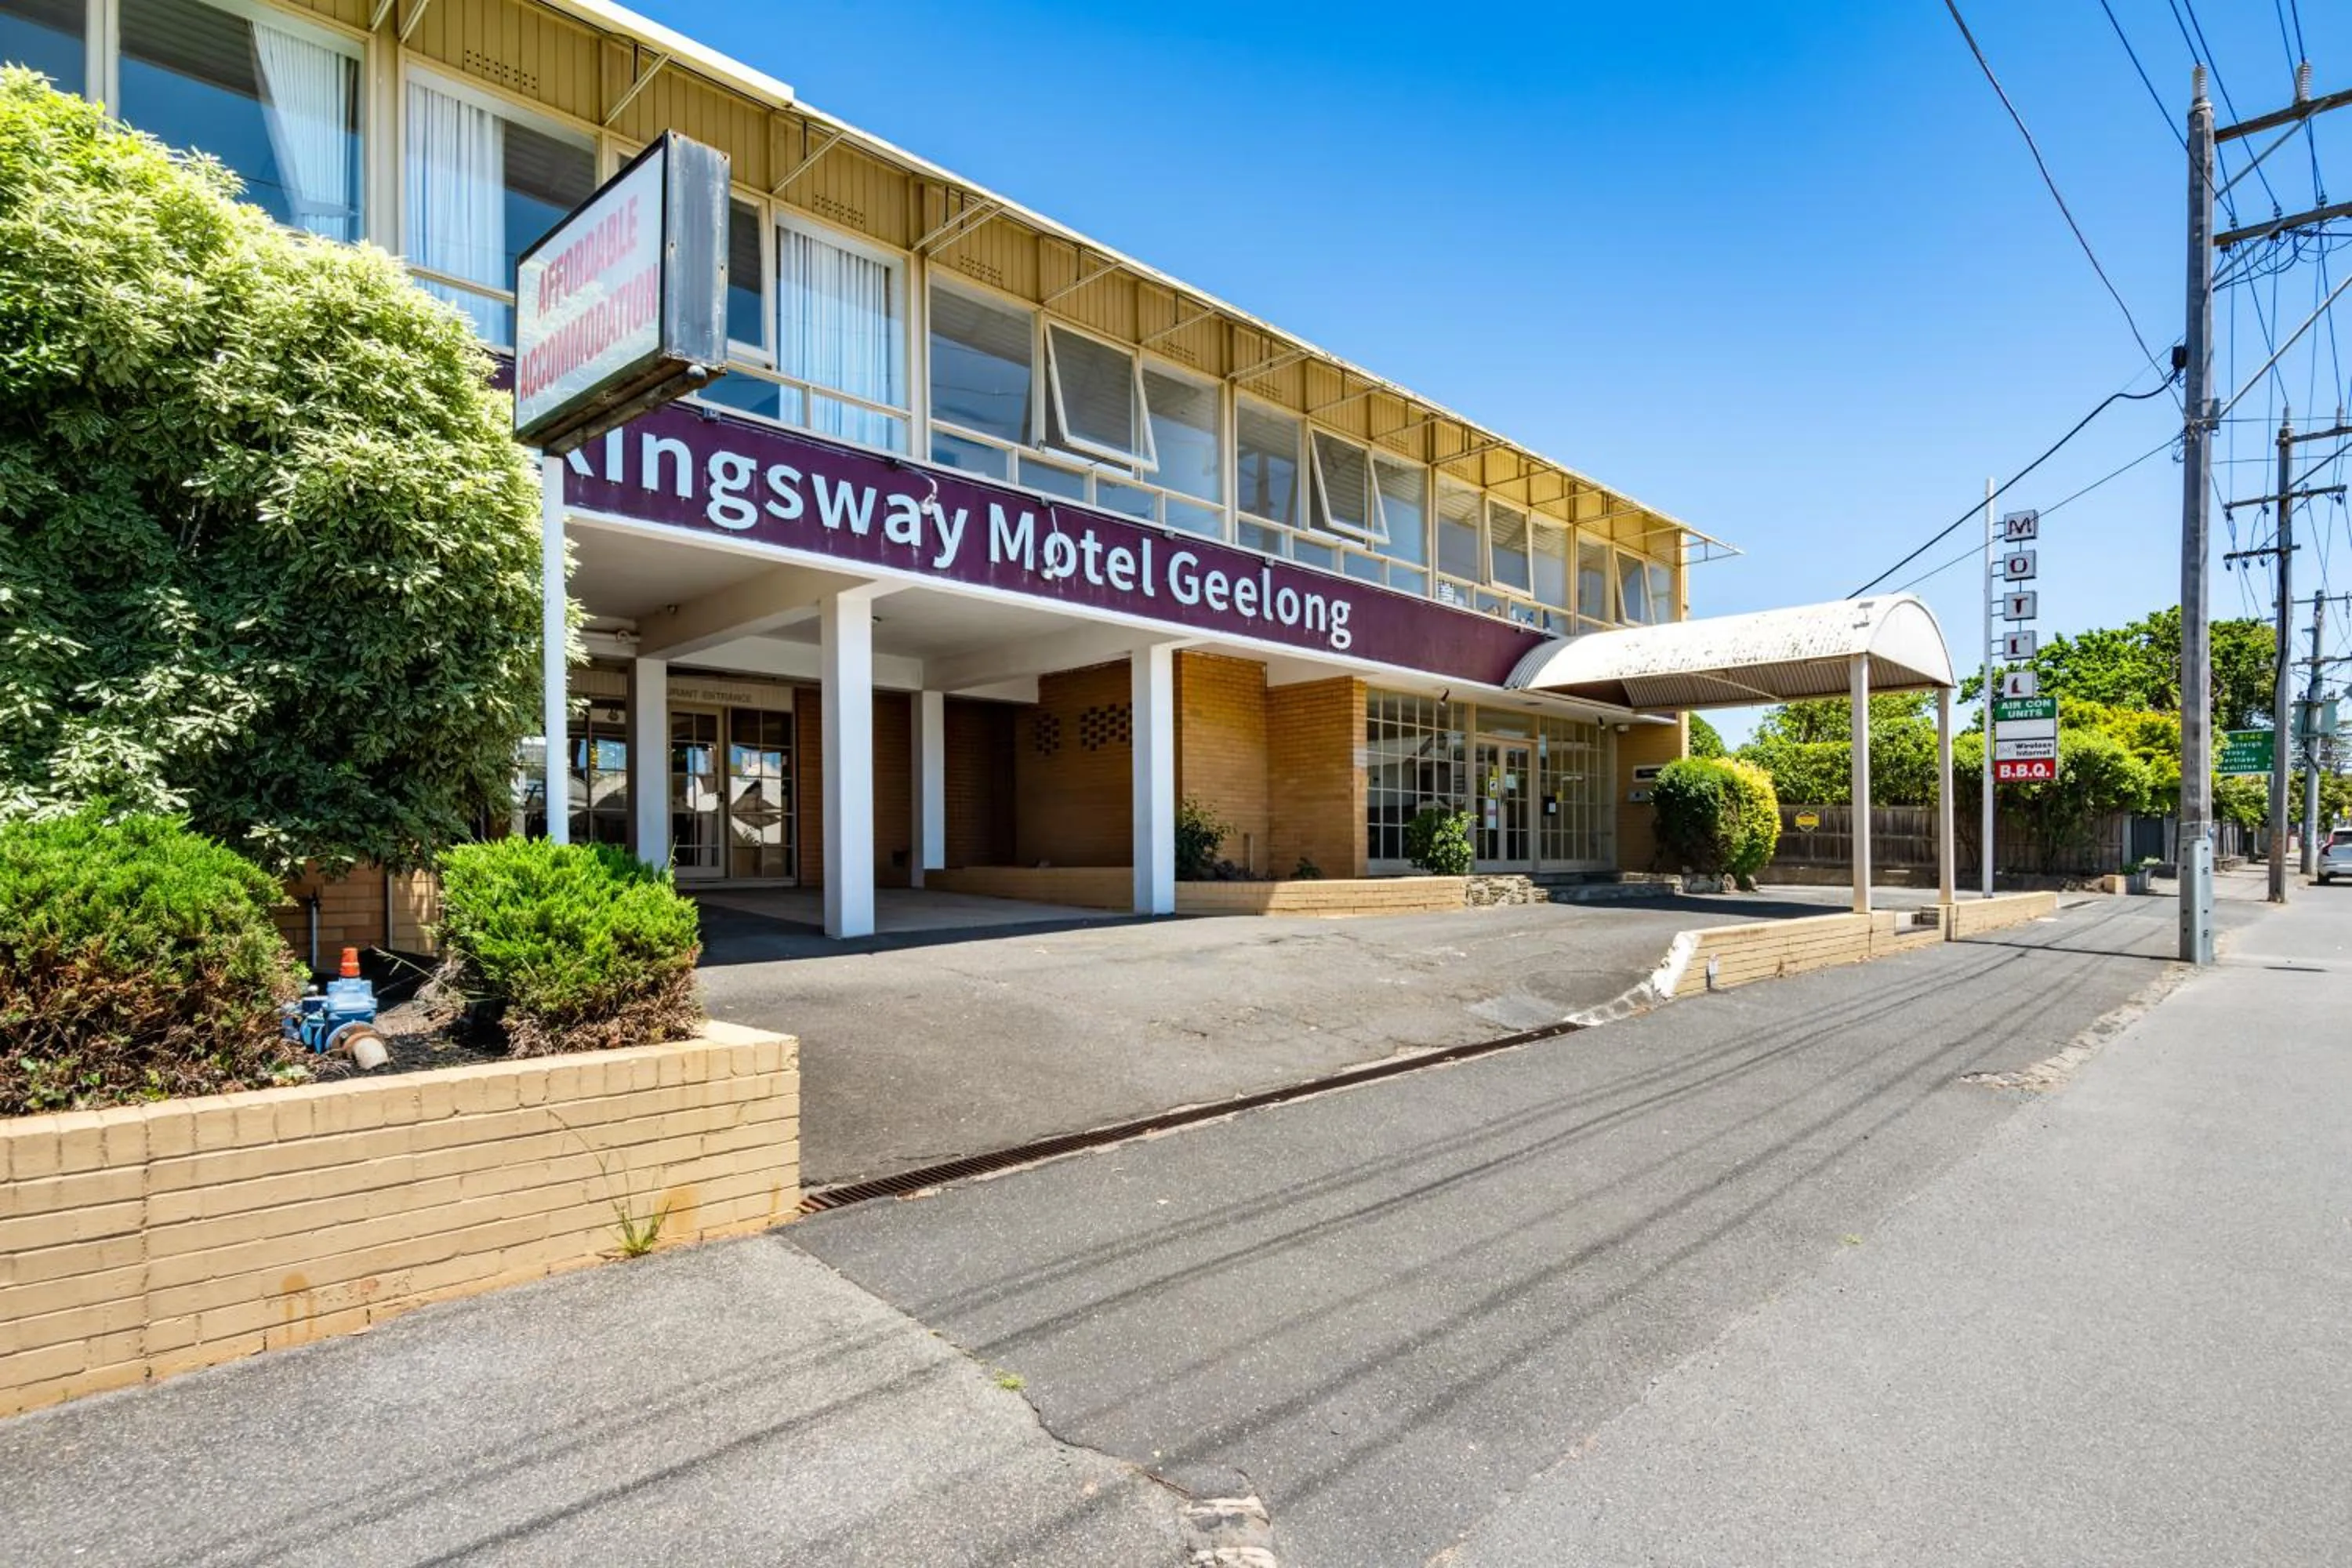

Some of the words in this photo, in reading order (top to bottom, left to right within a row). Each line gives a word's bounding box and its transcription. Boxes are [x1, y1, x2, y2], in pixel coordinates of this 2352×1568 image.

[538, 194, 637, 318] AFFORDABLE
[520, 263, 659, 401] ACCOMMODATION
[988, 502, 1155, 597] Motel
[1168, 550, 1352, 650] Geelong
[2001, 701, 2021, 710] AIR
[2025, 699, 2052, 708] CON
[2008, 709, 2043, 718] UNITS
[1999, 762, 2051, 779] B.B.Q.
